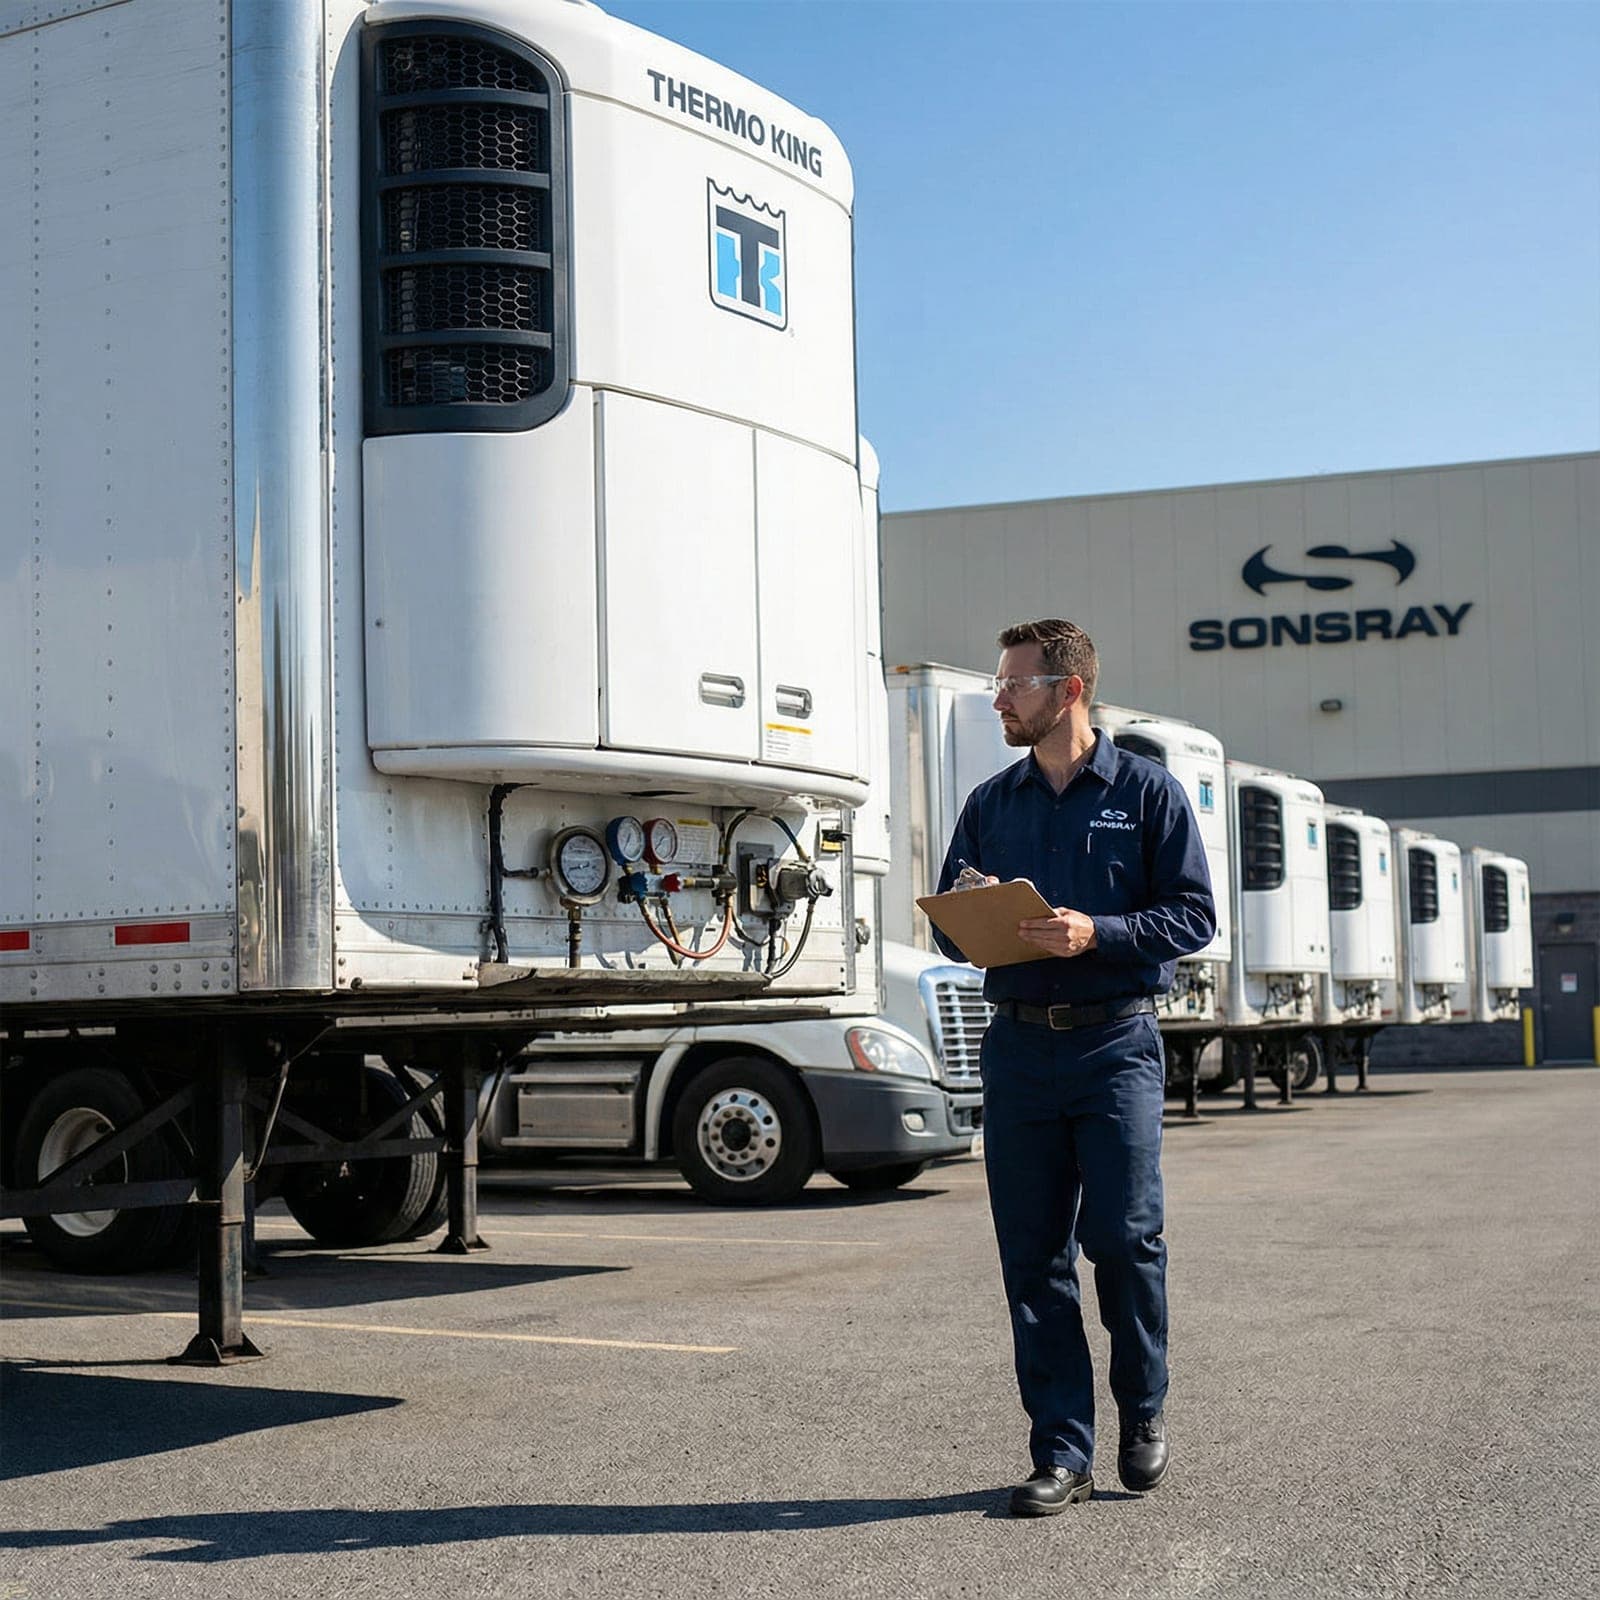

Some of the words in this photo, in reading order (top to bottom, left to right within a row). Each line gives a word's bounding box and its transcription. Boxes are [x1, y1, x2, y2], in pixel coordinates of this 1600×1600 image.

[647, 69, 765, 146] THERMO
[771, 124, 822, 178] KING
[1189, 602, 1474, 651] SONSRAY
[1089, 820, 1136, 831] SONSRAY
